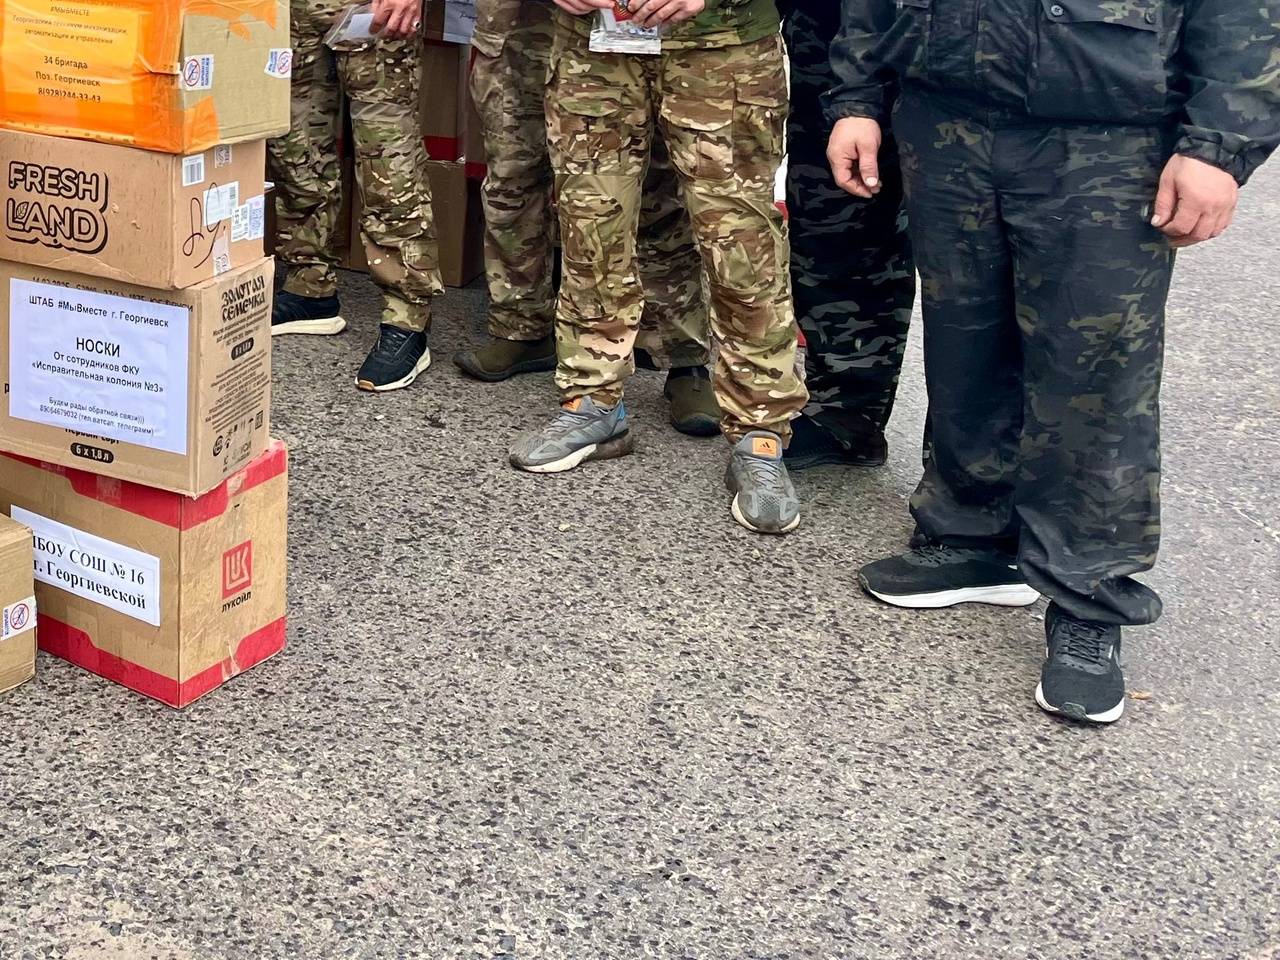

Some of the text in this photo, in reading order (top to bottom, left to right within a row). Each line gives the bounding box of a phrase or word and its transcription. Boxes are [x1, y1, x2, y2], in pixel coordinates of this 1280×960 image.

[43, 56, 88, 69] 34 бригада
[36, 71, 101, 87] Поз. Георгиевск
[9, 160, 99, 202] FRESH
[6, 198, 99, 243] LAND
[221, 275, 264, 307] ЗОЛОТАЯ
[29, 295, 169, 328] ШТАБ #МыВместе г. Георгиевск
[221, 291, 266, 323] СЕМЕЧКА
[76, 337, 120, 358] НОСКИ
[32, 361, 164, 393] «Исправительная колония №3»
[53, 351, 140, 376] От сотрудников ФКУ
[49, 397, 68, 407] Будем
[70, 401, 87, 411] рады
[88, 405, 118, 417] обратной
[117, 421, 154, 436] телеграмм)
[76, 445, 81, 454] 6
[33, 535, 144, 586] БОУ СОШ № 16
[46, 562, 146, 610] Георгиевской
[222, 592, 252, 613] ЛУКОЙЛ
